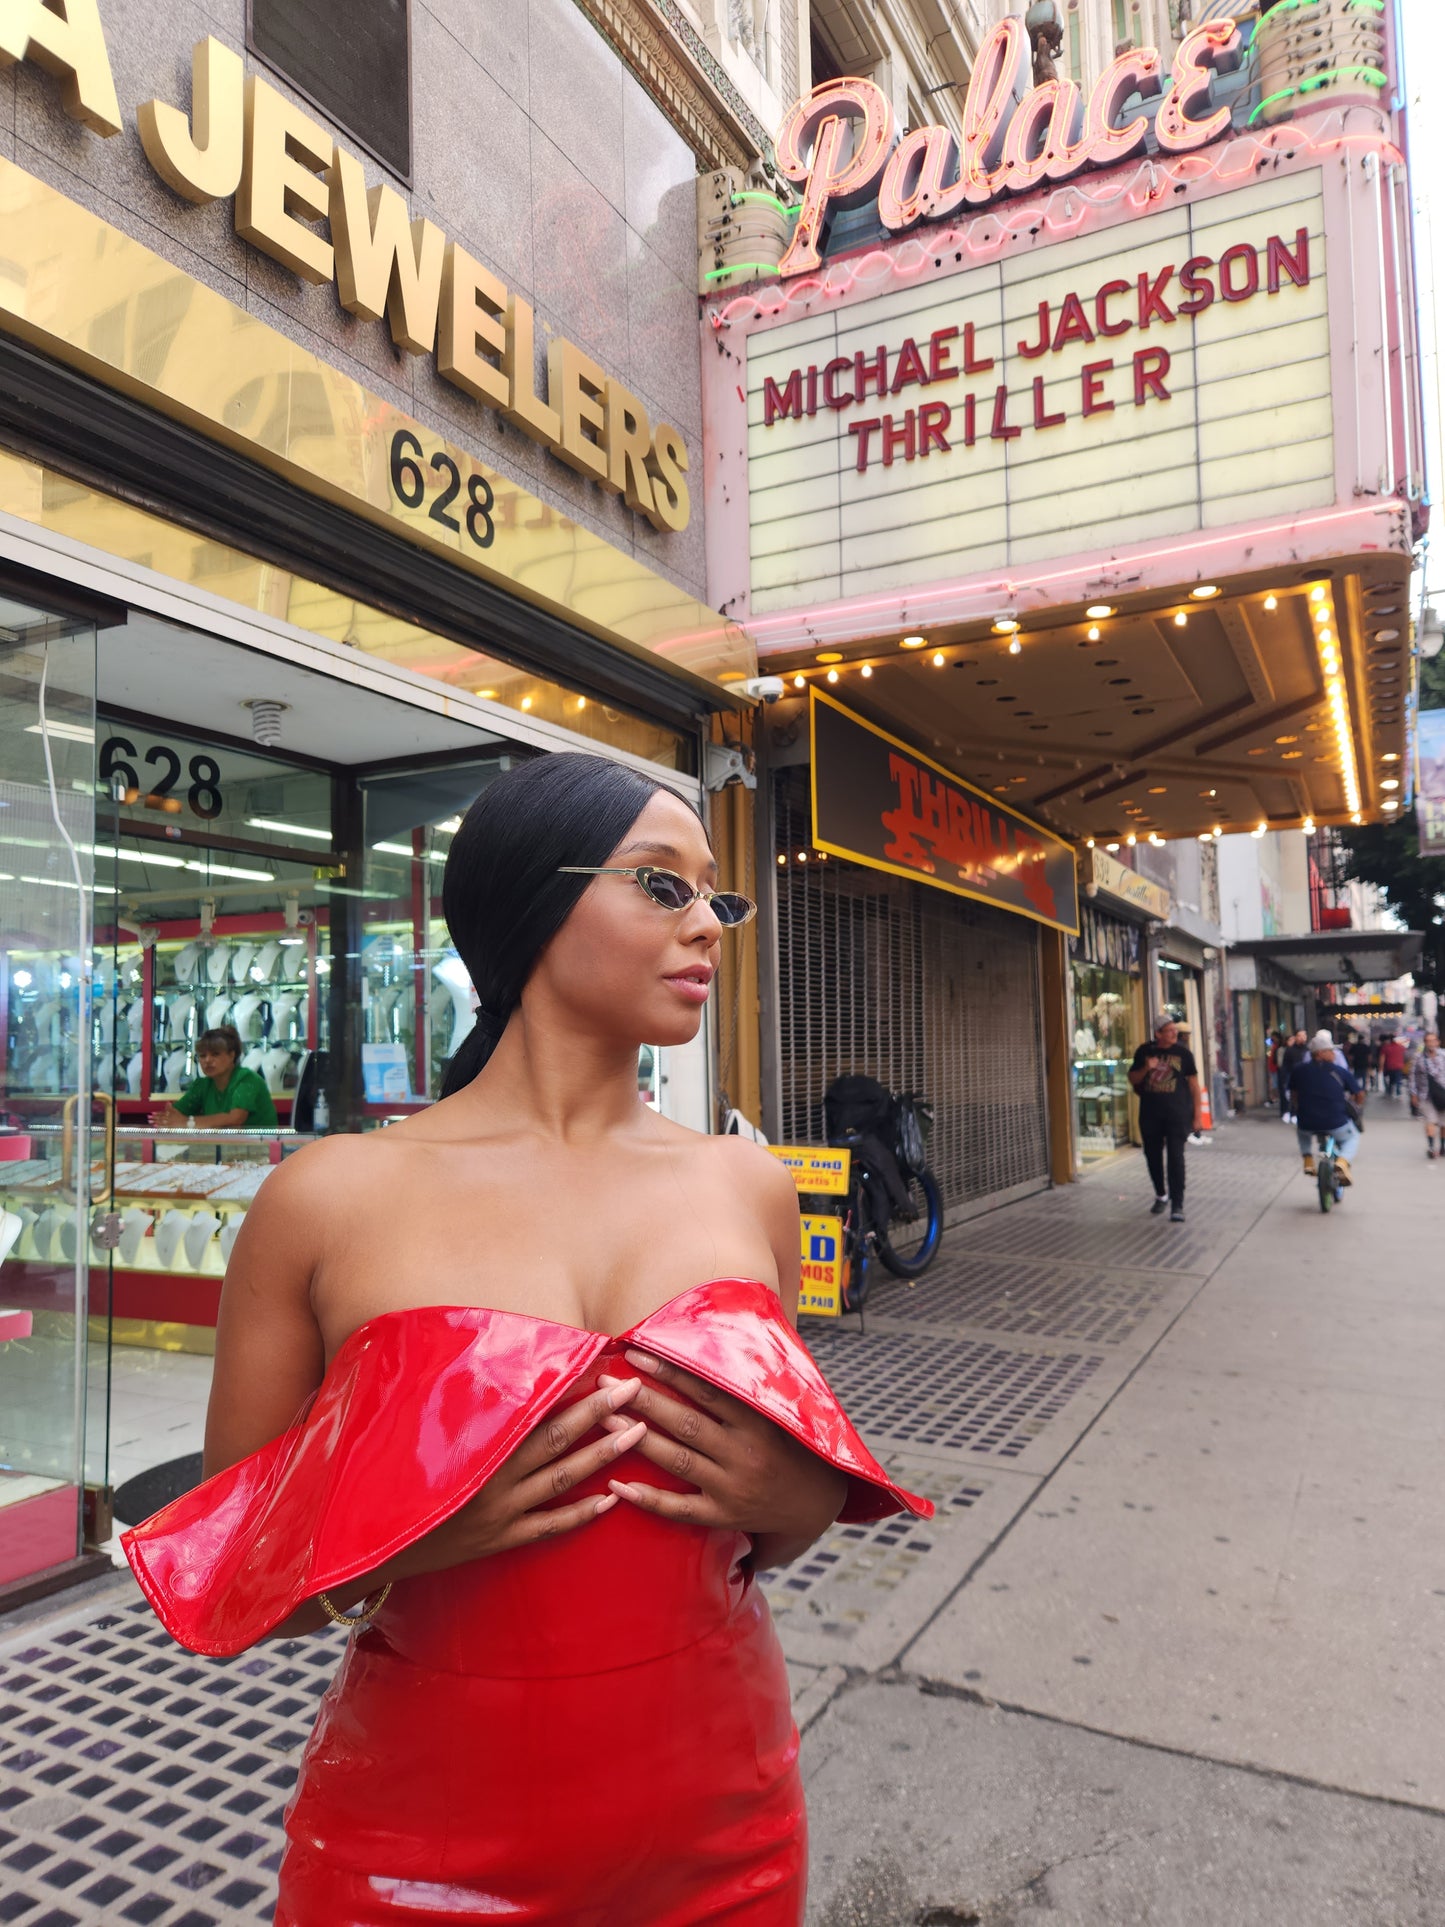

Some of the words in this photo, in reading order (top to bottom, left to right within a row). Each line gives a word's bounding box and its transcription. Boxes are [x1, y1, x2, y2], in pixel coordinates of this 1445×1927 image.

[137, 34, 691, 534] JEWELERS
[763, 321, 995, 426] MICHAEL
[1017, 226, 1311, 360] JACKSON
[848, 346, 1172, 472] THRILLER
[390, 428, 495, 549] 628
[99, 736, 223, 820] 628
[811, 1295, 833, 1308] PAID
